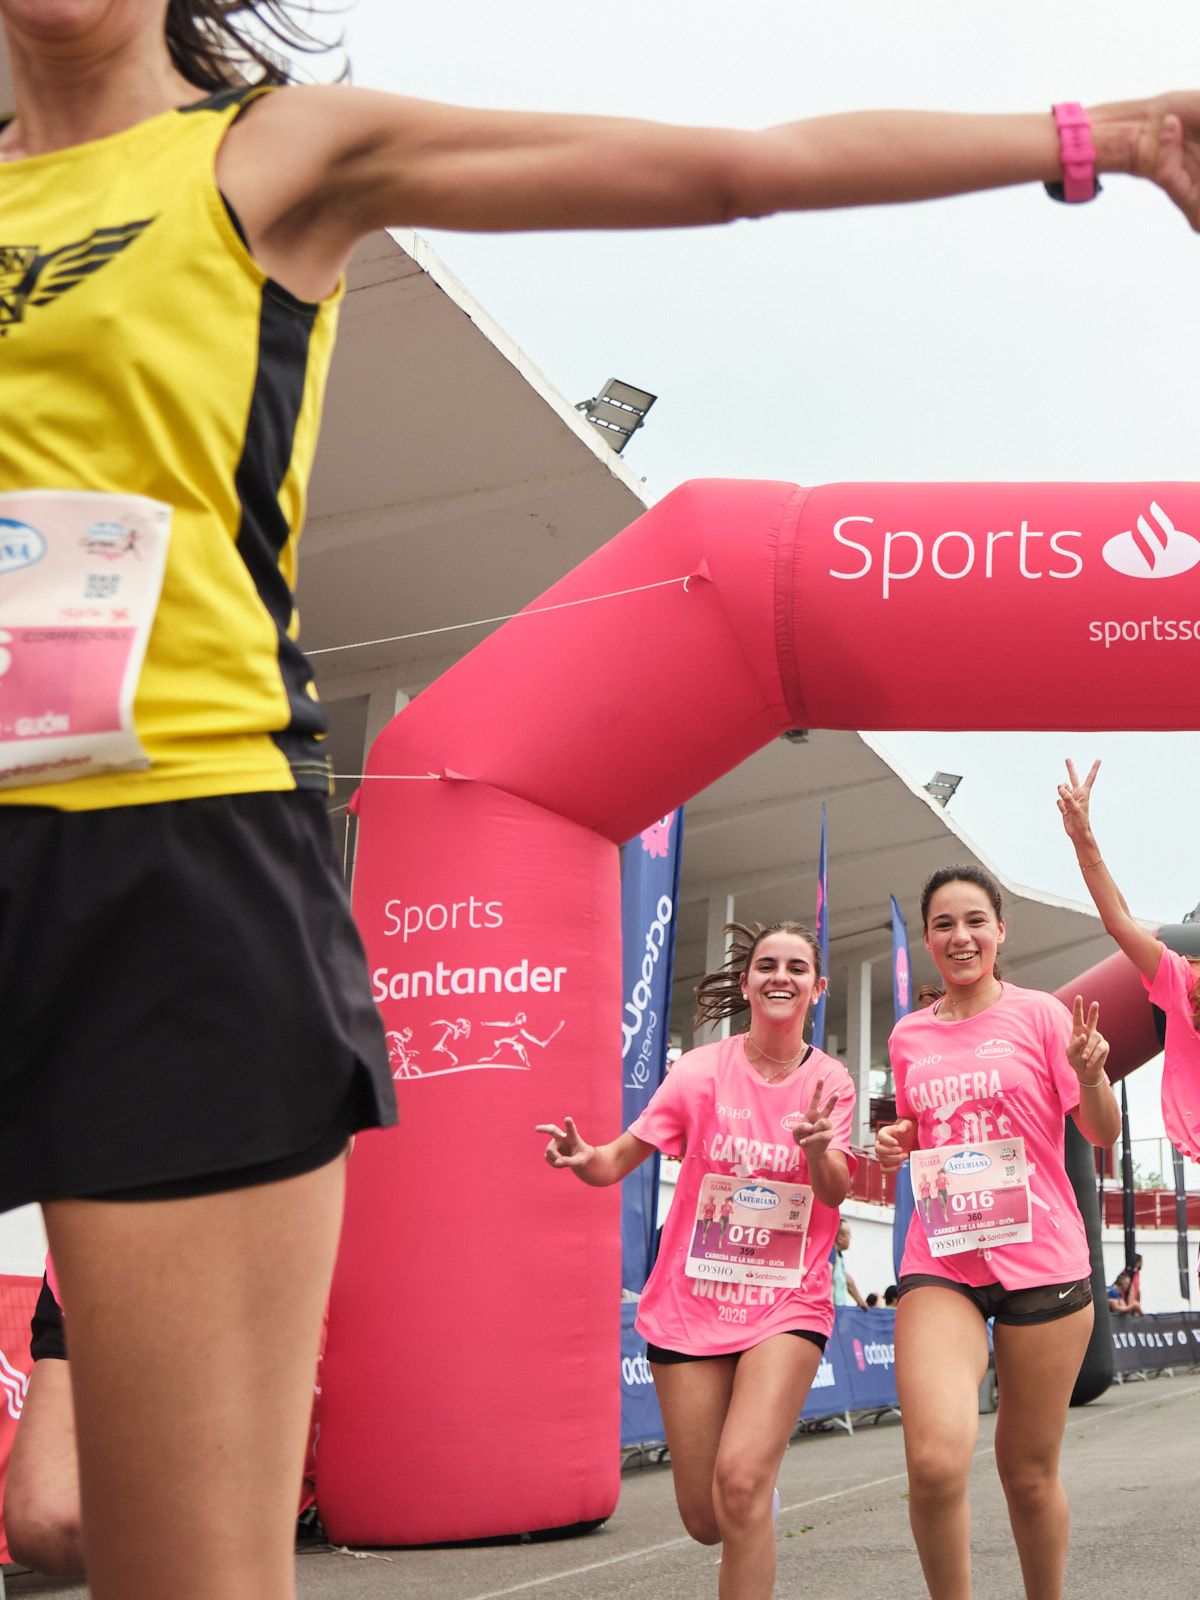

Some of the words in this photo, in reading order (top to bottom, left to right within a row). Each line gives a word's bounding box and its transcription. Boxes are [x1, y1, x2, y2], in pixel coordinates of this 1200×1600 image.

[828, 515, 1084, 599] Sports
[383, 895, 503, 943] Sports
[373, 958, 568, 1003] Santander
[909, 1068, 1004, 1114] CARRERA
[715, 1102, 751, 1120] OYSHO
[709, 1133, 801, 1173] CARRERA
[919, 1158, 942, 1168] SUMA
[947, 1160, 989, 1171] ASTURIANA
[710, 1184, 732, 1193] SUMA
[736, 1192, 778, 1206] ASTURIANA
[951, 1190, 995, 1213] 016
[967, 1212, 982, 1222] 360
[728, 1225, 771, 1247] 016
[933, 1226, 960, 1236] CARRERA
[932, 1237, 966, 1250] OYSHO
[986, 1231, 1019, 1242] Santander
[705, 1252, 729, 1261] CARRERA
[730, 1253, 738, 1261] DE
[739, 1247, 755, 1257] 359
[698, 1263, 733, 1276] OYSHO
[754, 1272, 787, 1281] Santander
[718, 1305, 747, 1325] 2026
[1137, 1330, 1188, 1348] VOLVO
